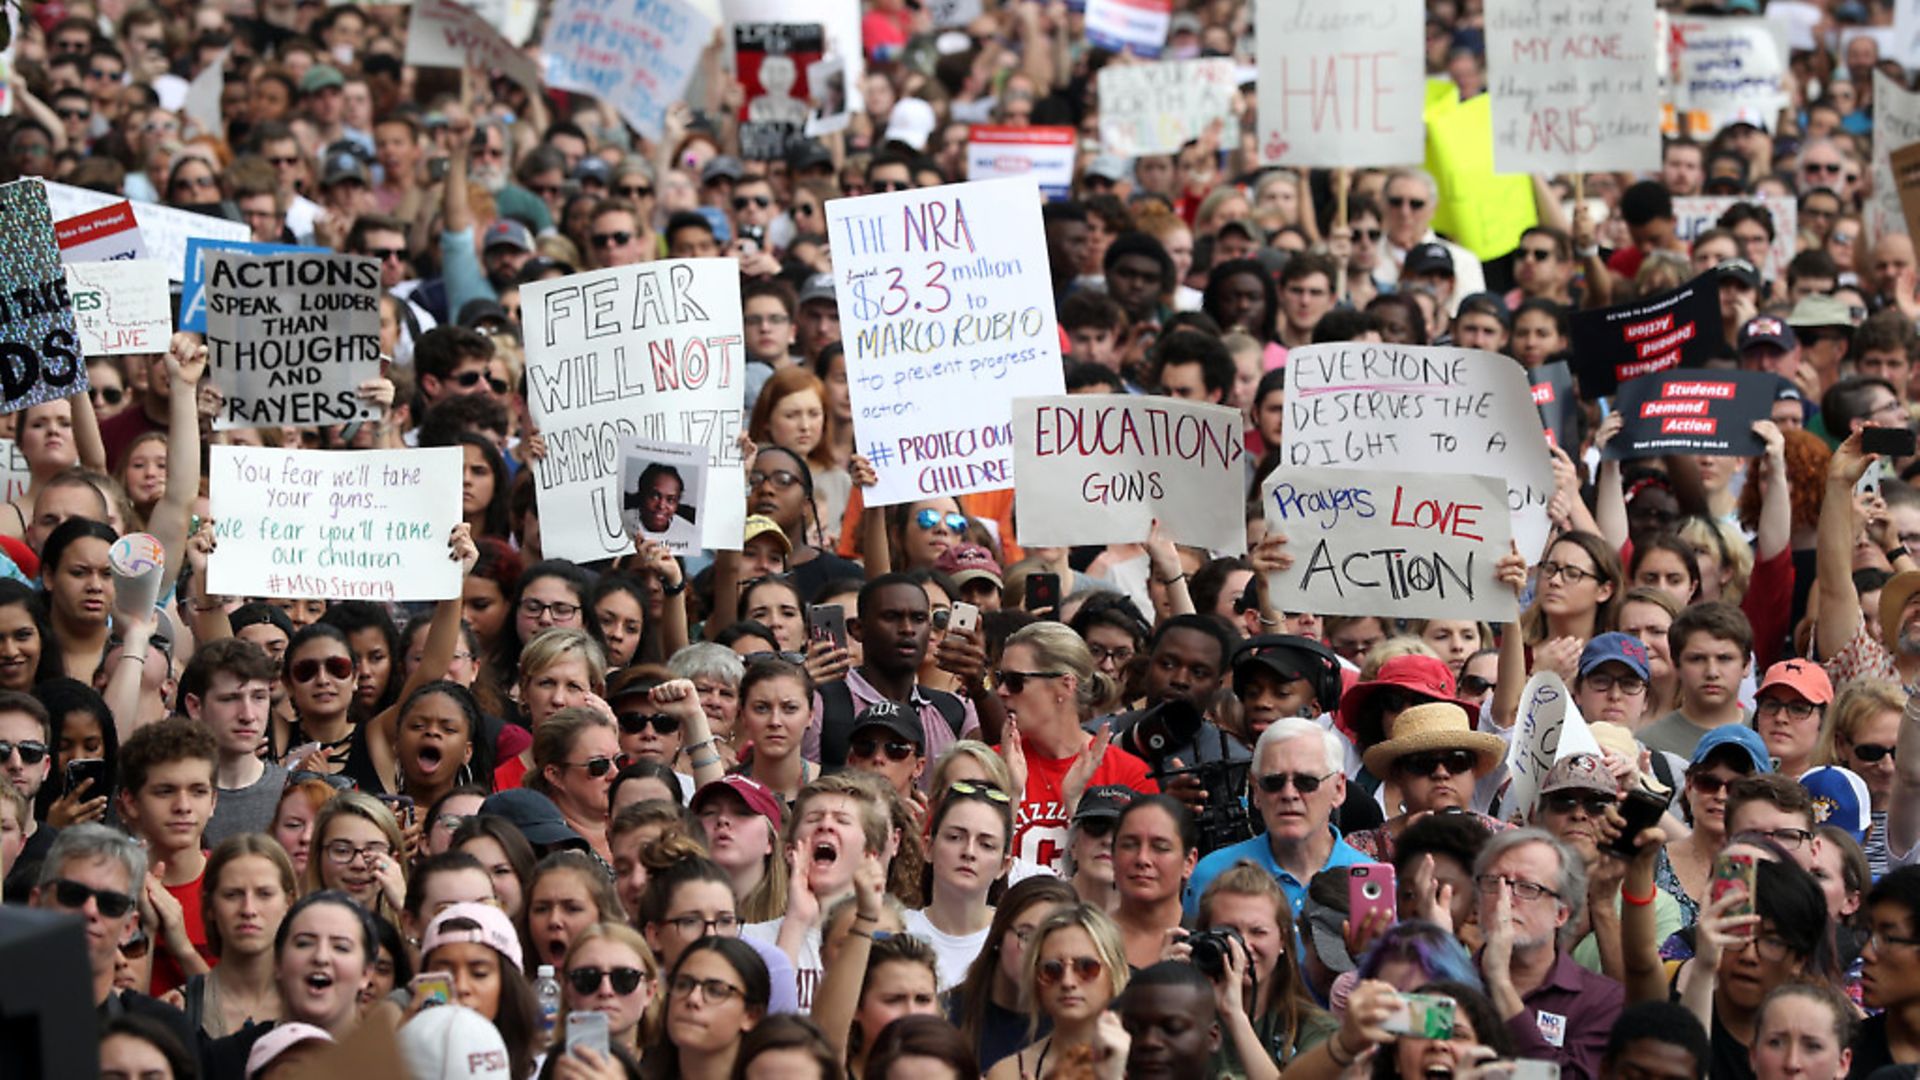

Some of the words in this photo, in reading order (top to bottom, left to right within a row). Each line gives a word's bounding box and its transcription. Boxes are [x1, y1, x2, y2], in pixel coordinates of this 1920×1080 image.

[1512, 36, 1552, 64] MY
[1280, 49, 1399, 134] HATE
[78, 222, 93, 234] the
[837, 215, 887, 256] THE
[903, 198, 977, 254] NRA
[211, 259, 380, 289] ACTIONS
[852, 261, 951, 321] $3.3
[952, 257, 1023, 281] million
[210, 292, 282, 316] SPEAK
[301, 293, 378, 312] LOUDER
[545, 264, 709, 347] FEAR
[966, 293, 988, 310] to
[104, 329, 148, 349] LIVE
[262, 315, 328, 336] THAN
[857, 318, 945, 360] MARCO
[953, 306, 1044, 347] RUBIO
[1628, 316, 1670, 338] Action
[209, 334, 381, 371] THOUGHTS
[1642, 326, 1692, 357] Demand
[268, 367, 322, 388] AND
[530, 347, 644, 414] WILL
[648, 335, 742, 393] NOT
[857, 373, 885, 391] to
[893, 360, 964, 388] prevent
[1295, 347, 1469, 391] EVERYONE
[1666, 383, 1730, 397] Students
[1291, 391, 1424, 431] DESERVES
[1434, 392, 1495, 418] THE
[1645, 402, 1704, 415] Demand
[1665, 419, 1713, 433] Action
[1430, 433, 1458, 453] TO
[1486, 431, 1508, 453] A
[233, 456, 271, 483] You
[282, 456, 324, 487] fear
[333, 464, 370, 488] we'll
[383, 463, 422, 487] take
[918, 459, 1013, 494] CHILDRE
[1083, 470, 1164, 505] GUNS
[1272, 483, 1376, 530] Prayers
[1391, 485, 1483, 541] LOVE
[259, 516, 305, 540] fear
[319, 521, 373, 549] you'll
[386, 518, 433, 542] take
[272, 548, 307, 566] our
